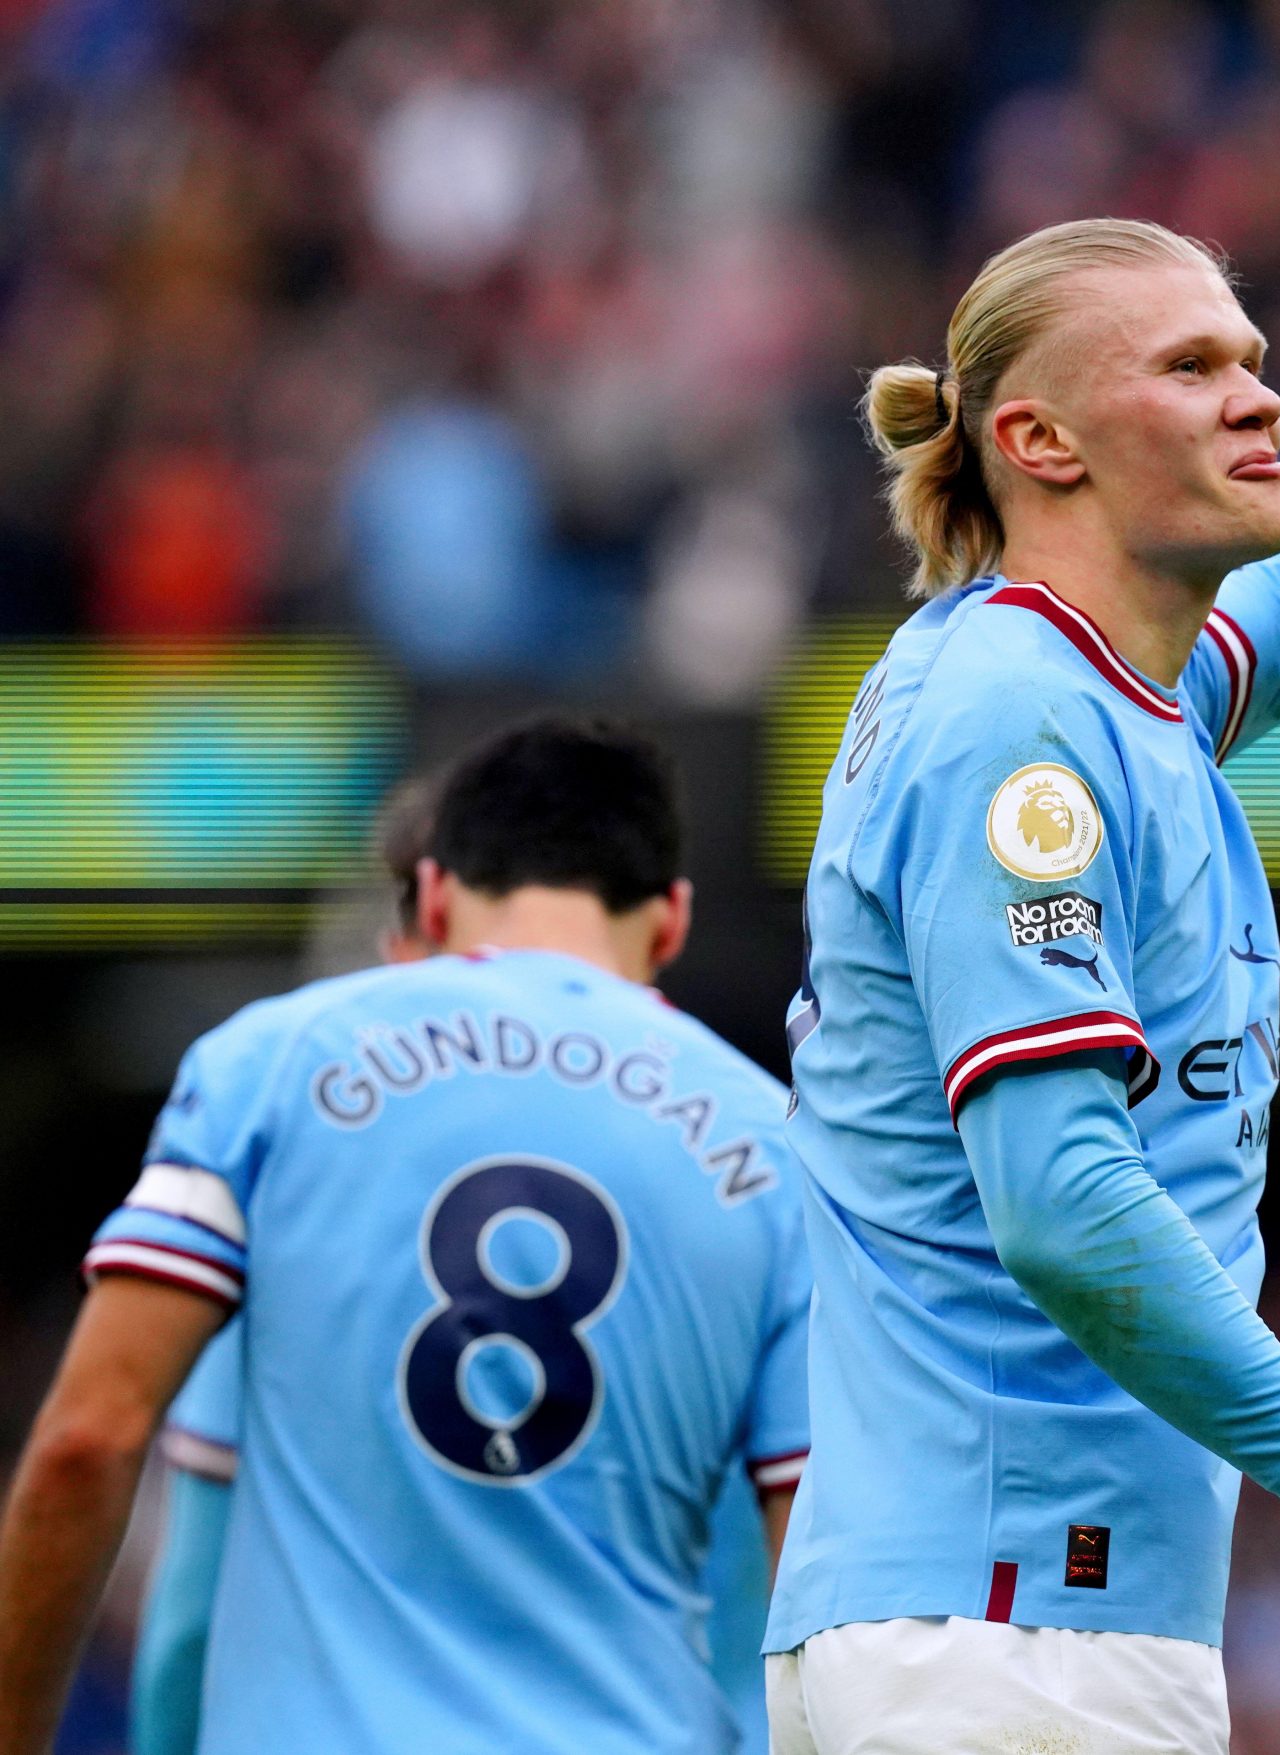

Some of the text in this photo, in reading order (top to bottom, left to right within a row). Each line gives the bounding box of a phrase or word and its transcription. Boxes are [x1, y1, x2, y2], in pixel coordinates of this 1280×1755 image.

[1080, 809, 1091, 846] 2021/22
[1006, 898, 1097, 926] No room
[1011, 916, 1104, 946] for racm
[311, 1012, 780, 1208] GÜNDOĞAN
[397, 1153, 631, 1488] 8
